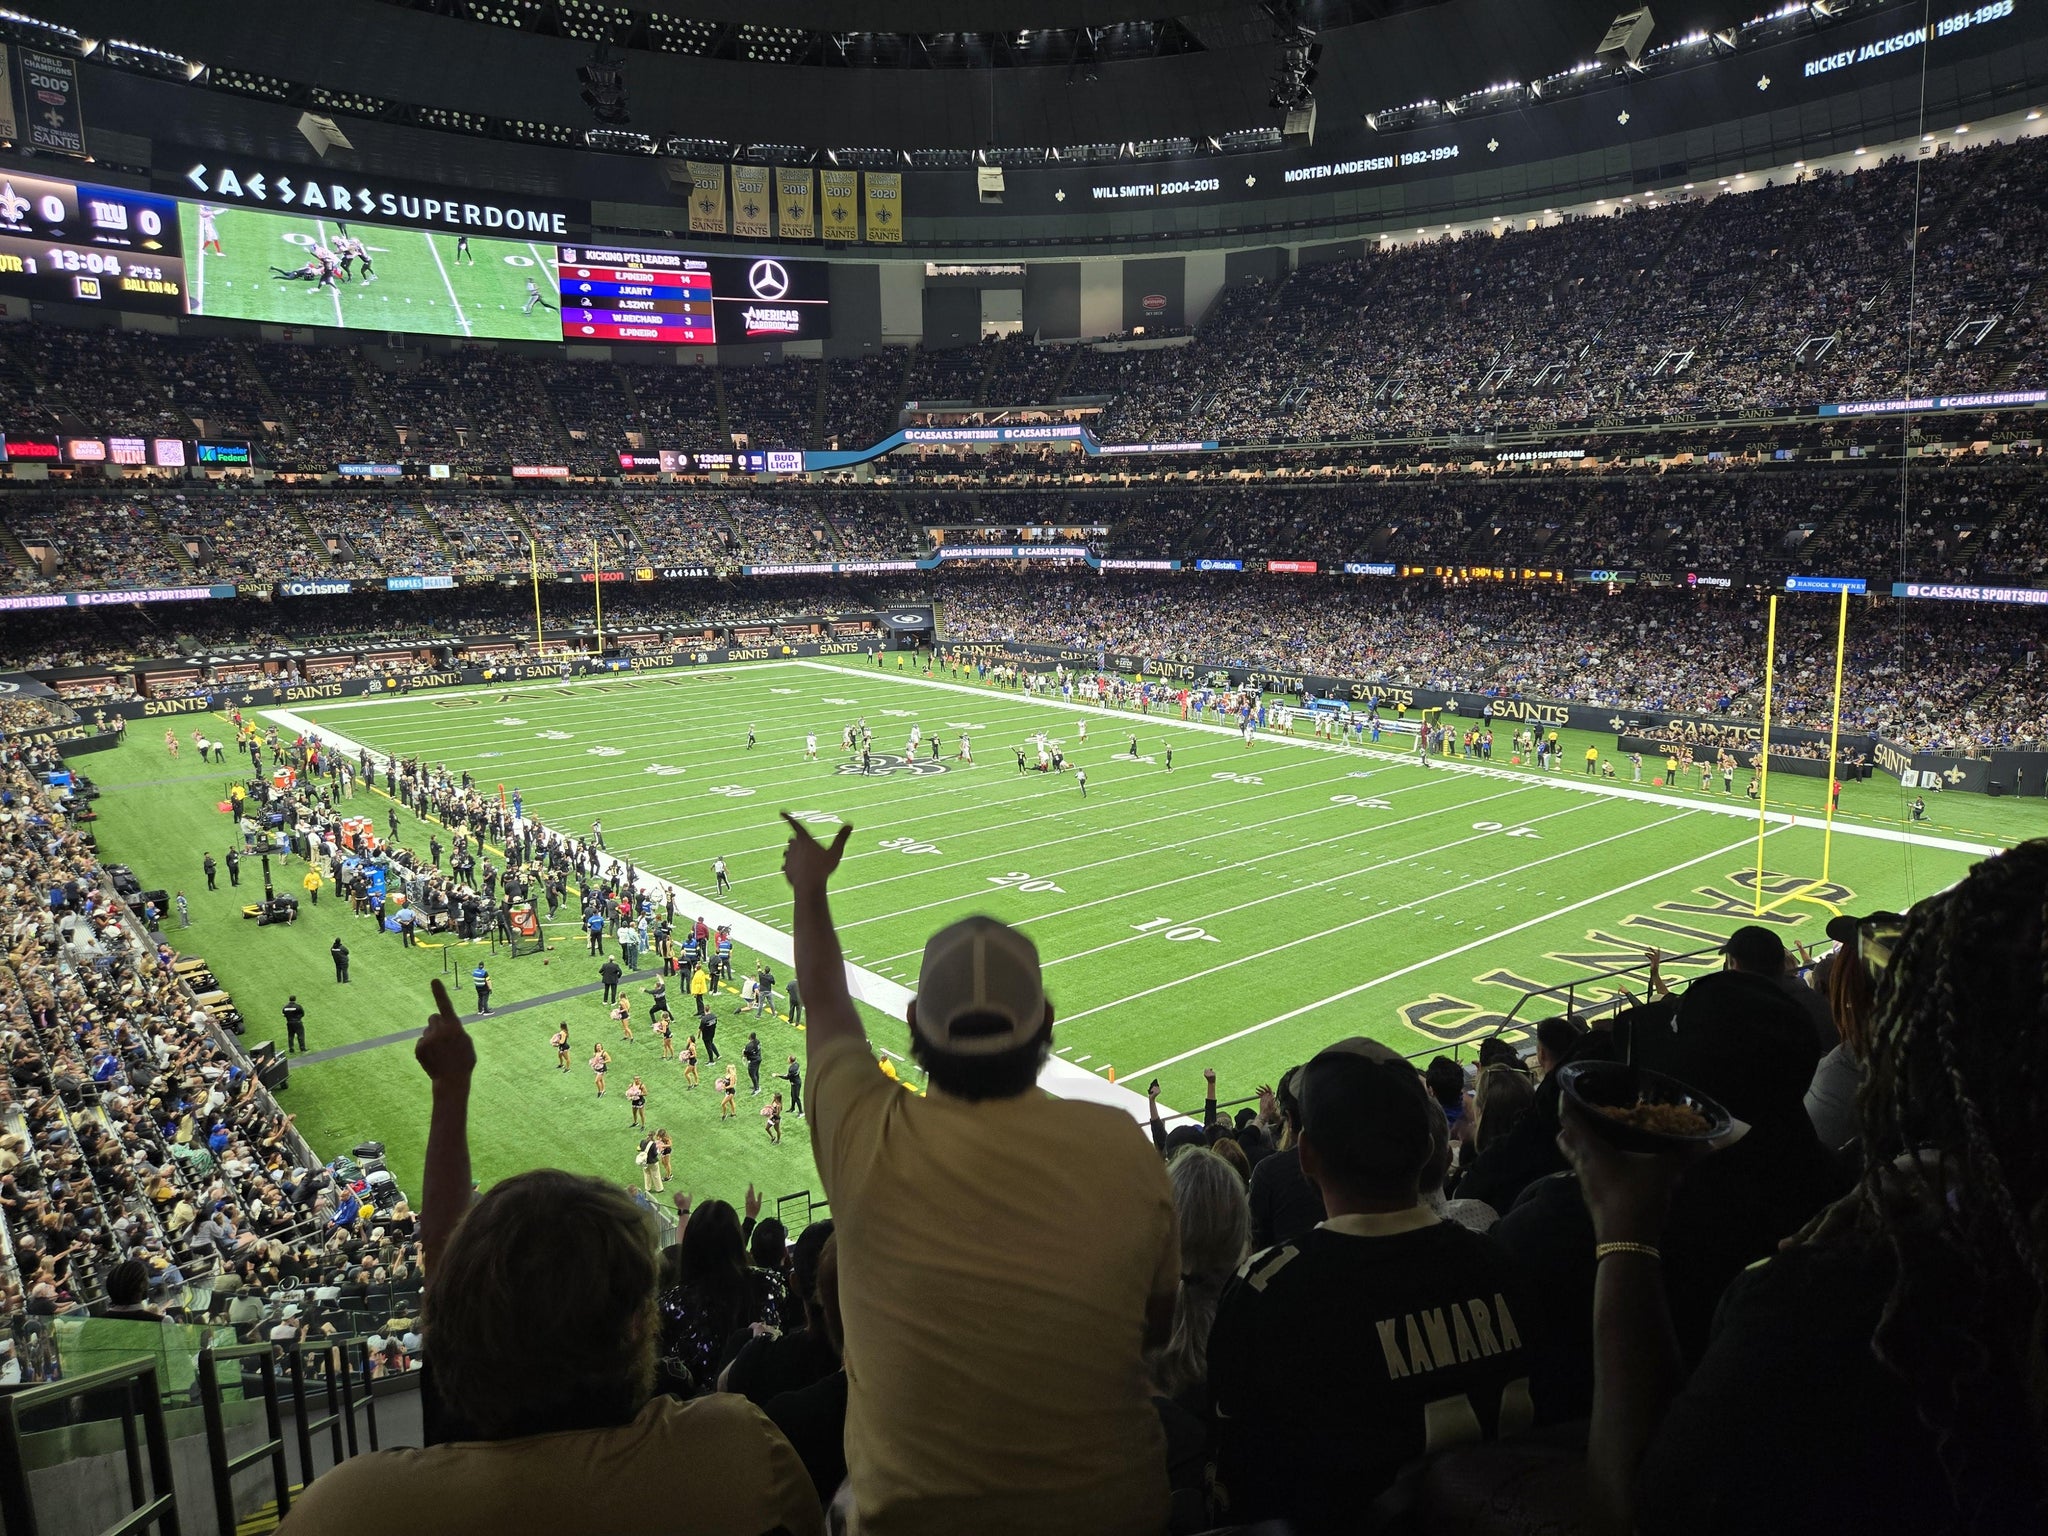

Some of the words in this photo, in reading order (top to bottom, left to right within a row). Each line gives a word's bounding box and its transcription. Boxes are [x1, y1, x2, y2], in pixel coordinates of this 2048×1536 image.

[1805, 50, 1855, 77] RICKEY
[1857, 28, 1926, 62] JACKSON
[1937, 0, 2014, 37] 1981-1993
[33, 54, 62, 67] WORLD
[24, 59, 72, 76] CHAMPIONS
[30, 73, 69, 92] 2009
[34, 131, 80, 150] SAINTS
[1285, 168, 1330, 183] MORTEN
[1333, 156, 1393, 176] ANDERSEN
[1400, 145, 1459, 165] 1982-1994
[695, 180, 717, 190] 2011
[739, 183, 762, 193] 2017
[783, 184, 808, 195] 2018
[1093, 186, 1118, 199] WILL
[1120, 184, 1154, 197] SMITH
[1161, 178, 1219, 195] 2004-2013
[827, 187, 852, 197] 2019
[870, 188, 896, 199] 2020
[188, 164, 376, 215] CAESARS
[380, 194, 567, 234] SUPERDOME
[42, 196, 65, 222] 0
[140, 210, 161, 235] 0
[692, 221, 724, 232] SAINTS
[736, 225, 768, 235] SAINTS
[781, 228, 812, 237] SAINTS
[825, 230, 856, 239] SAINTS
[869, 231, 900, 241] SAINTS
[49, 249, 121, 276] 13:04
[585, 250, 623, 263] KICKING
[624, 253, 640, 263] PTS
[642, 254, 680, 266] LEADERS
[25, 258, 37, 274] 1
[680, 275, 691, 284] 14
[124, 278, 148, 292] BALL
[150, 281, 163, 293] ON
[164, 282, 179, 295] 46
[683, 331, 694, 340] 14
[1949, 396, 1993, 407] CAESARS
[1993, 391, 2046, 403] SPORTSBOOK
[1847, 402, 1886, 413] CAESARS
[1886, 400, 1933, 410] SPORTSBOOK
[1663, 414, 1696, 423] SAINTS
[1738, 408, 1775, 419] SAINTS
[1528, 423, 1557, 432] SAINTS
[1594, 419, 1625, 428] SAINTS
[914, 430, 952, 440] CAESARS
[954, 430, 999, 439] SPORTSBOOK
[1013, 429, 1051, 438] CAESARS
[1351, 432, 1376, 441] SAINTS
[1406, 430, 1433, 438] SAINTS
[1991, 431, 2034, 441] SAINTS
[1746, 442, 1779, 450] SAINTS
[1822, 438, 1858, 447] SAINTS
[217, 446, 247, 455] Keesler
[1496, 452, 1537, 461] CAESARS
[1538, 450, 1585, 459] SUPERDOME
[217, 454, 248, 462] Federal
[633, 457, 660, 465] TOYOTA
[773, 454, 795, 462] BUD
[771, 461, 799, 470] LIGHT
[1025, 548, 1060, 556] CAESARS
[759, 566, 793, 574] CAESARS
[847, 563, 880, 571] CAESARS
[1352, 563, 1393, 574] Ochsner
[465, 574, 495, 582] SAINTS
[637, 569, 651, 579] 40
[664, 568, 709, 578] CAESARS
[1591, 570, 1618, 581] COX
[238, 582, 273, 592] SAINTS
[389, 579, 422, 589] PEOPLES
[1698, 577, 1731, 587] entergy
[291, 583, 349, 595] Ochsner
[1920, 586, 1980, 599] CAESARS
[1982, 589, 2048, 603] SPORTSBOO
[0, 595, 67, 608] SPORTSBOOK
[91, 591, 148, 604] CAESARS
[149, 588, 211, 600] SPORTSBOOK
[820, 643, 858, 655] SAINTS
[728, 649, 768, 661] SAINTS
[630, 655, 674, 669] SAINTS
[1150, 661, 1194, 679] SAINTS
[286, 684, 342, 700] SAINTS
[1351, 685, 1413, 705] SAINTS
[144, 697, 208, 716] SAINTS
[1492, 699, 1569, 724] SAINTS
[1660, 744, 1693, 754] SAINS
[1873, 743, 1912, 775] SAINTS
[878, 837, 930, 855] 30
[987, 871, 1056, 893] 20
[1129, 916, 1200, 942] 10
[1396, 867, 1857, 1052] SAINTS
[1375, 1293, 1522, 1381] KAMARA
